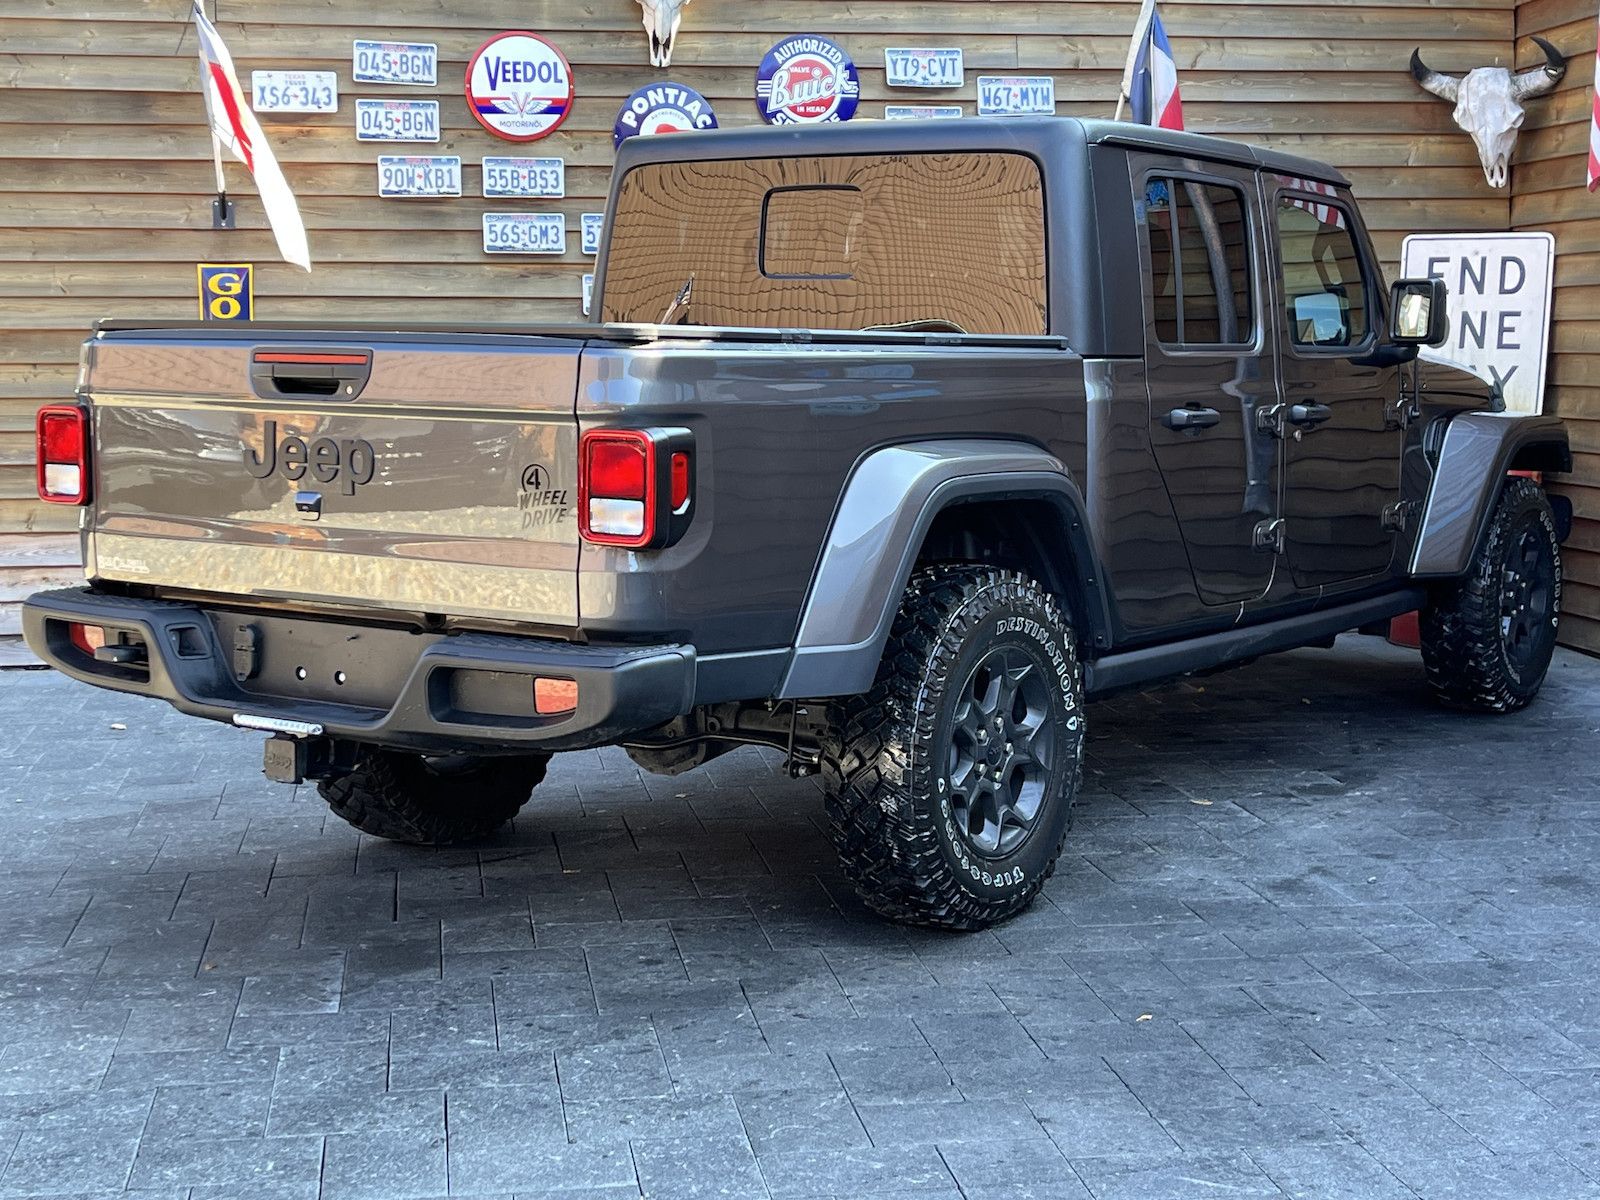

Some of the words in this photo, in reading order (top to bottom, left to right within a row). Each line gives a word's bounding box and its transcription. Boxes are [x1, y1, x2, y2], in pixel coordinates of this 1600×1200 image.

[358, 51, 392, 73] 045
[400, 53, 432, 76] BGN
[773, 38, 842, 64] AUTHORIZED
[484, 56, 563, 91] VEEDOL
[890, 58, 919, 76] Y79
[928, 58, 958, 77] CVT
[257, 86, 291, 106] XS6
[299, 86, 332, 106] 343
[767, 62, 859, 113] Buick
[982, 87, 1012, 106] W67
[621, 87, 712, 129] PONTIAC
[361, 110, 394, 131] 045
[402, 111, 434, 132] BGN
[242, 420, 375, 496] Jeep
[519, 490, 567, 511] WHEEL
[521, 508, 567, 530] DRIVE
[995, 616, 1076, 711] DESTINATION
